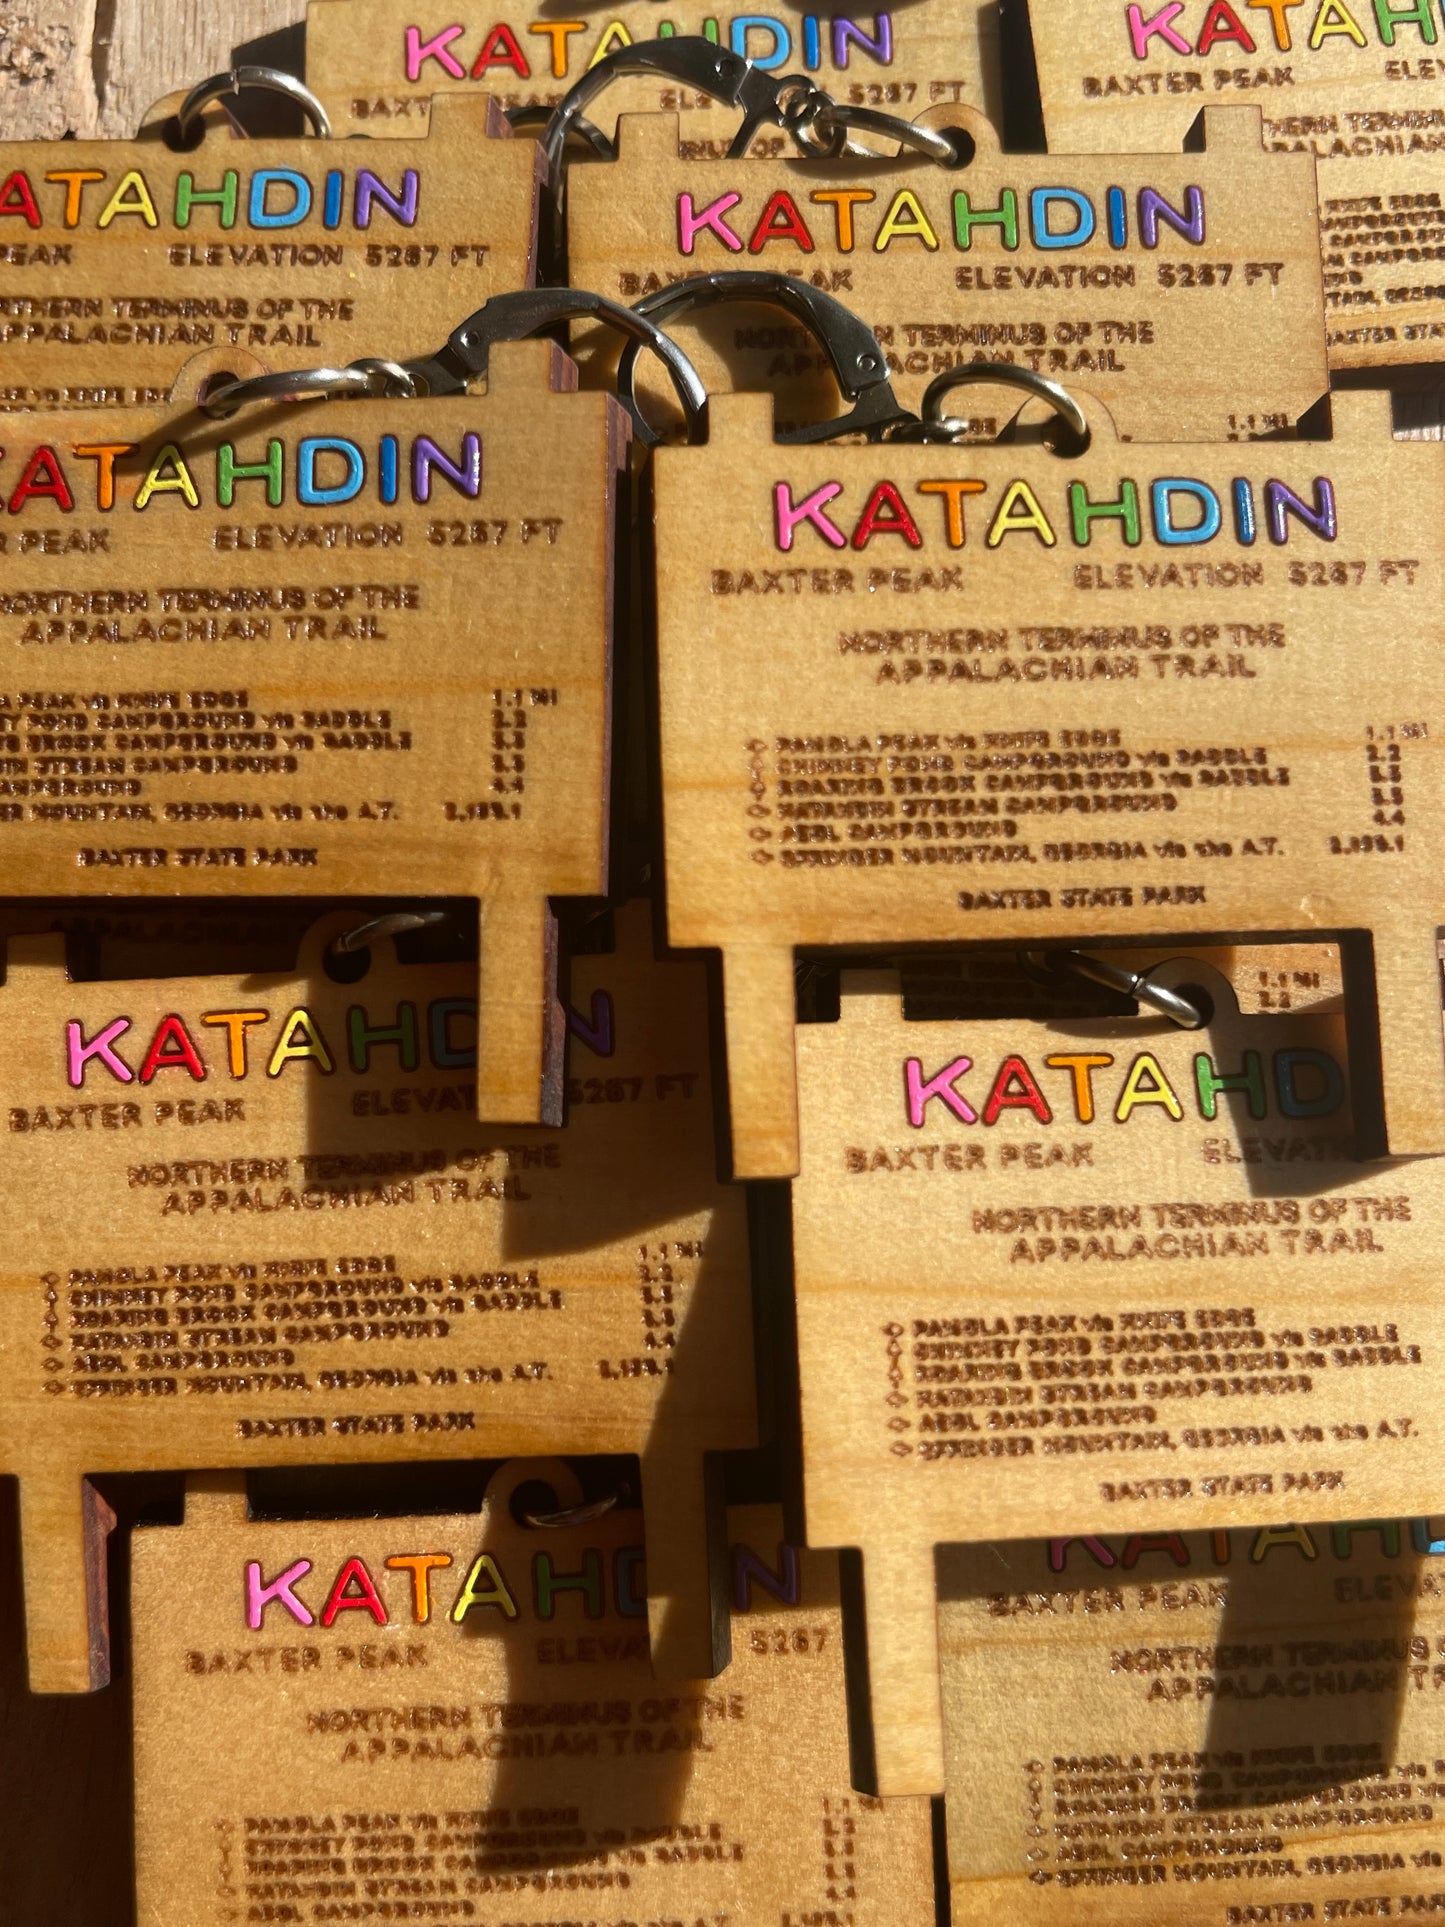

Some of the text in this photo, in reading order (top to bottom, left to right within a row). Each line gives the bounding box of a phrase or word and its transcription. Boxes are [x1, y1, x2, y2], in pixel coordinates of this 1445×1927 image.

[1126, 0, 1445, 59] KATAH
[403, 12, 893, 82] KATADIN
[928, 81, 966, 103] FT
[1082, 66, 1296, 97] BAXTER PEAK
[676, 185, 1206, 256] KATAHDIN
[168, 243, 344, 268] ELEVATION
[449, 243, 490, 267] FT
[954, 264, 1137, 290] ELEVATION
[1244, 262, 1286, 287] FT
[112, 297, 249, 320] TERMINUS
[255, 298, 294, 320] OF
[302, 298, 354, 321] THE
[224, 322, 322, 347] TRAIL
[902, 322, 1047, 346] TERMINUS
[1053, 321, 1093, 345] OF
[1097, 321, 1155, 344] THE
[1024, 349, 1126, 372] TRAIL
[0, 432, 482, 512] ATAHDIN
[773, 476, 1338, 551] KATAHDIN
[18, 527, 111, 553] PEAK
[212, 522, 403, 551] ELEVATION
[520, 517, 563, 545] FT
[710, 568, 855, 595] BAXTER
[866, 566, 964, 593] PEAK
[1073, 562, 1264, 590] ELEVATION
[1379, 559, 1420, 585] FT
[157, 587, 307, 612] TERMINUS
[312, 586, 355, 610] OF
[357, 585, 421, 609] THE
[20, 615, 387, 645] APPALACHIAN TRAIL
[838, 621, 1286, 655] NORTHERN TERMINUS OF THE
[874, 653, 1257, 685] APPALACHIAN TRAIL
[67, 989, 615, 1089] KATAHDN
[8, 1102, 142, 1133] BAXTER
[154, 1098, 245, 1126] PEAK
[655, 1073, 699, 1100] FT
[903, 1048, 1345, 1129] KATAHD
[127, 1157, 289, 1188] NORTHERN
[456, 1150, 498, 1172] OF
[845, 1143, 988, 1173] BAXTER
[1000, 1141, 1095, 1170] PEAK
[160, 1174, 532, 1217] APPALACHIAN TRAIL
[972, 1195, 1412, 1234] NORTHERN TERMINUS OF THE
[1010, 1228, 1385, 1263] APPALACHIAN TRAIL
[986, 1591, 1124, 1617] BAXTER
[1138, 1582, 1230, 1611] PEAK
[184, 1647, 321, 1676] BAXTER
[335, 1644, 428, 1670] PEAK
[1110, 1643, 1274, 1674] NORTHERN
[1147, 1667, 1399, 1702] APPALACHIAN
[306, 1706, 472, 1735] NORTHERN
[340, 1735, 592, 1764] APPALACHIAN
